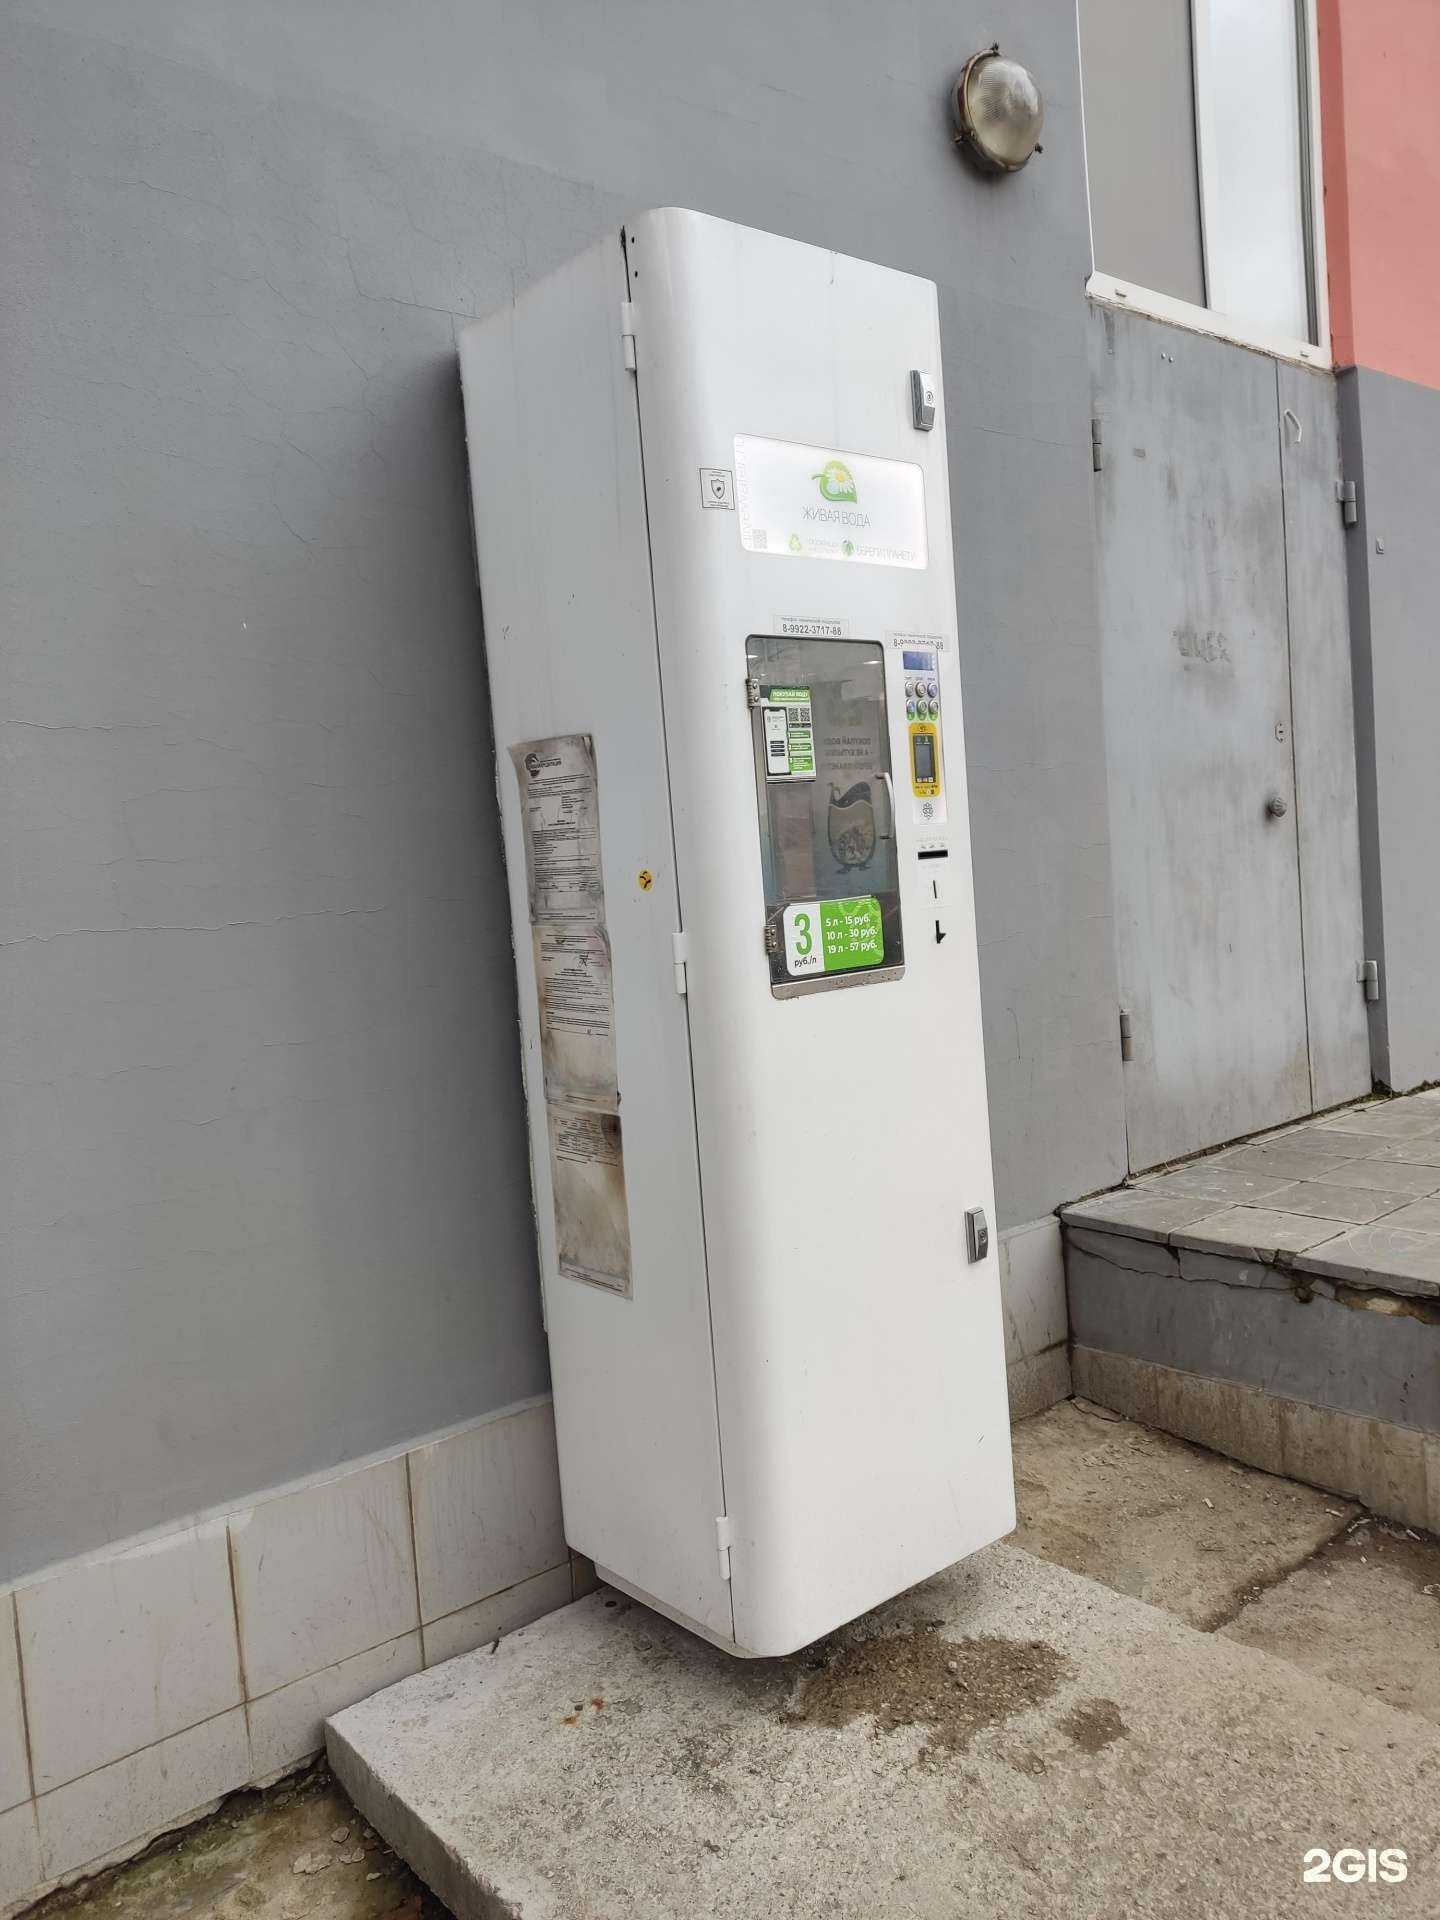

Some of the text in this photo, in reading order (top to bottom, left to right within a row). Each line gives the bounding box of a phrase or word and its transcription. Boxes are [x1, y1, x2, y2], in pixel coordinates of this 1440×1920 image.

[802, 505, 871, 527] ЖИВАЯ ВОДА
[782, 623, 842, 636] 8-9922-3717-88
[825, 918, 831, 927] 5
[845, 916, 853, 924] 15
[854, 913, 871, 926] руб.
[794, 913, 812, 955] 3
[826, 932, 835, 940] 10
[837, 931, 843, 939] л
[849, 928, 859, 938] 30
[860, 926, 878, 939] руб.
[827, 945, 837, 954] 19
[837, 945, 844, 953] л
[849, 942, 859, 951] 57
[861, 940, 878, 952] руб.
[794, 956, 817, 968] руб./л
